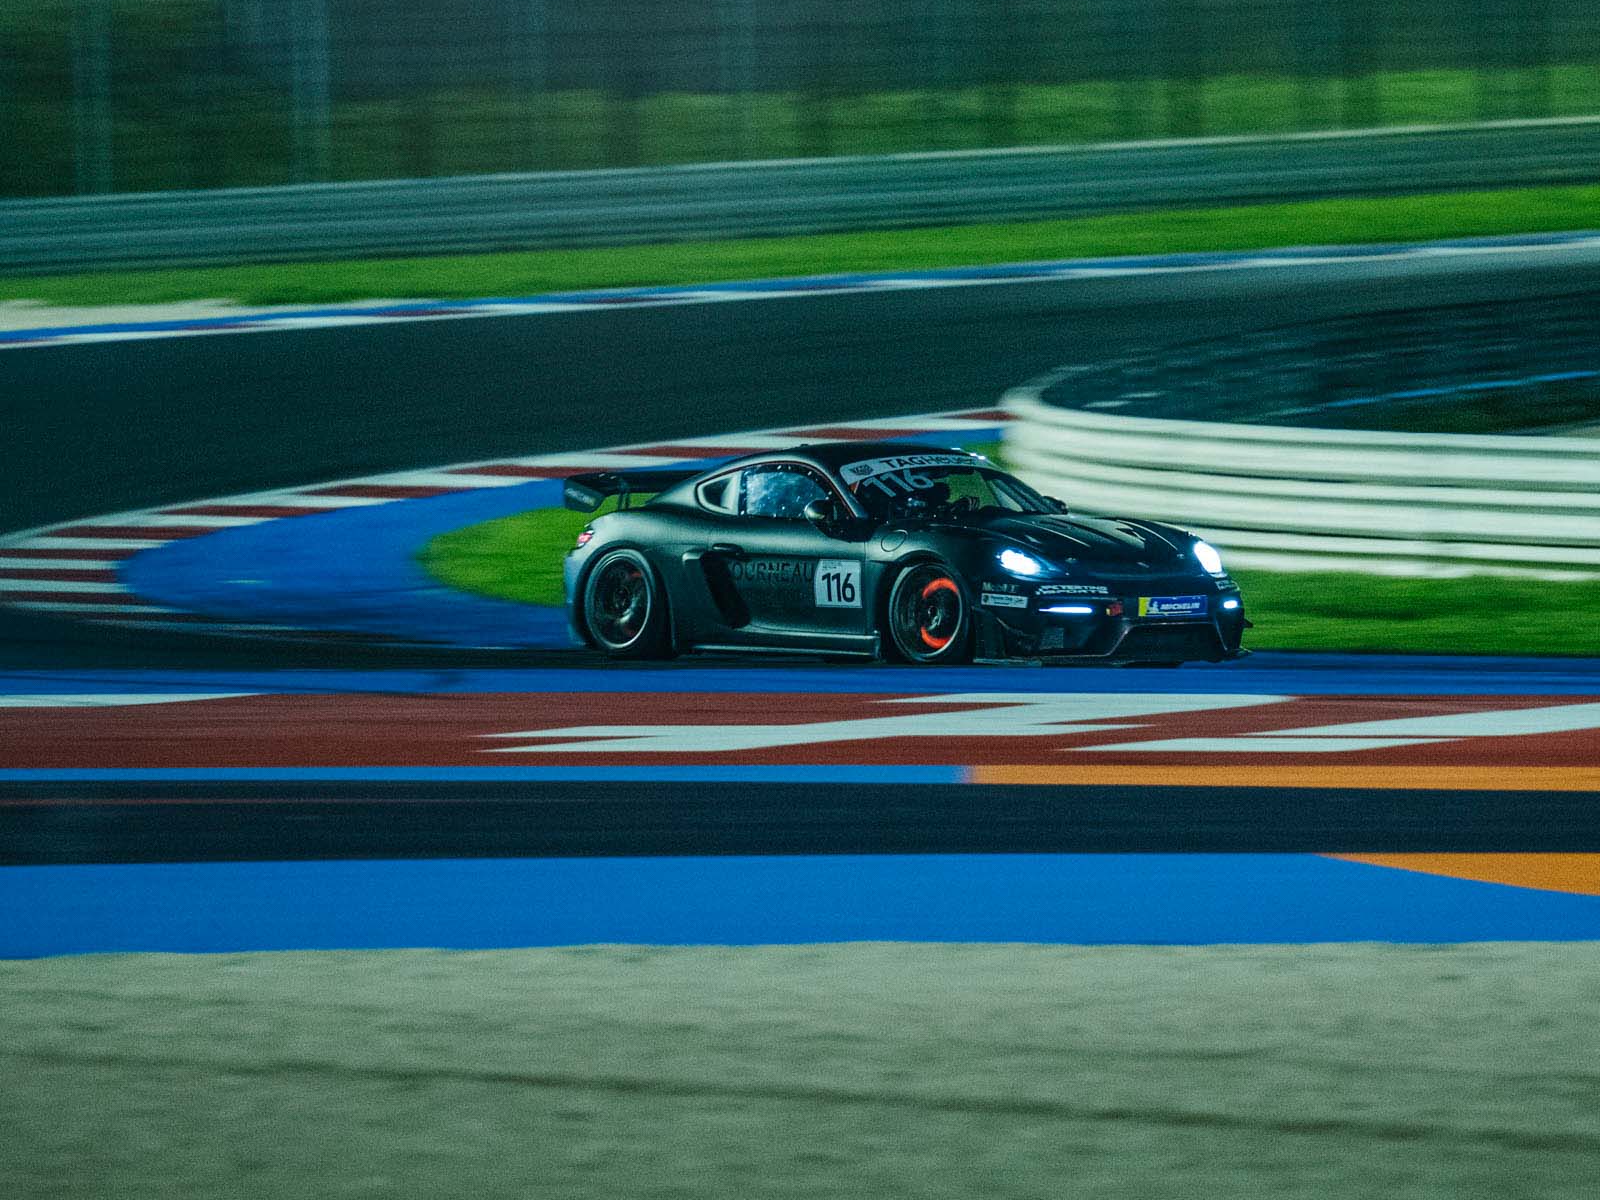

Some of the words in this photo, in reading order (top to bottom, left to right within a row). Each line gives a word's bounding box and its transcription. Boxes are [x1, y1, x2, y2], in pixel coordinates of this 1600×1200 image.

[862, 465, 934, 498] 116
[821, 572, 856, 603] 116
[1160, 602, 1201, 610] MICHELIN
